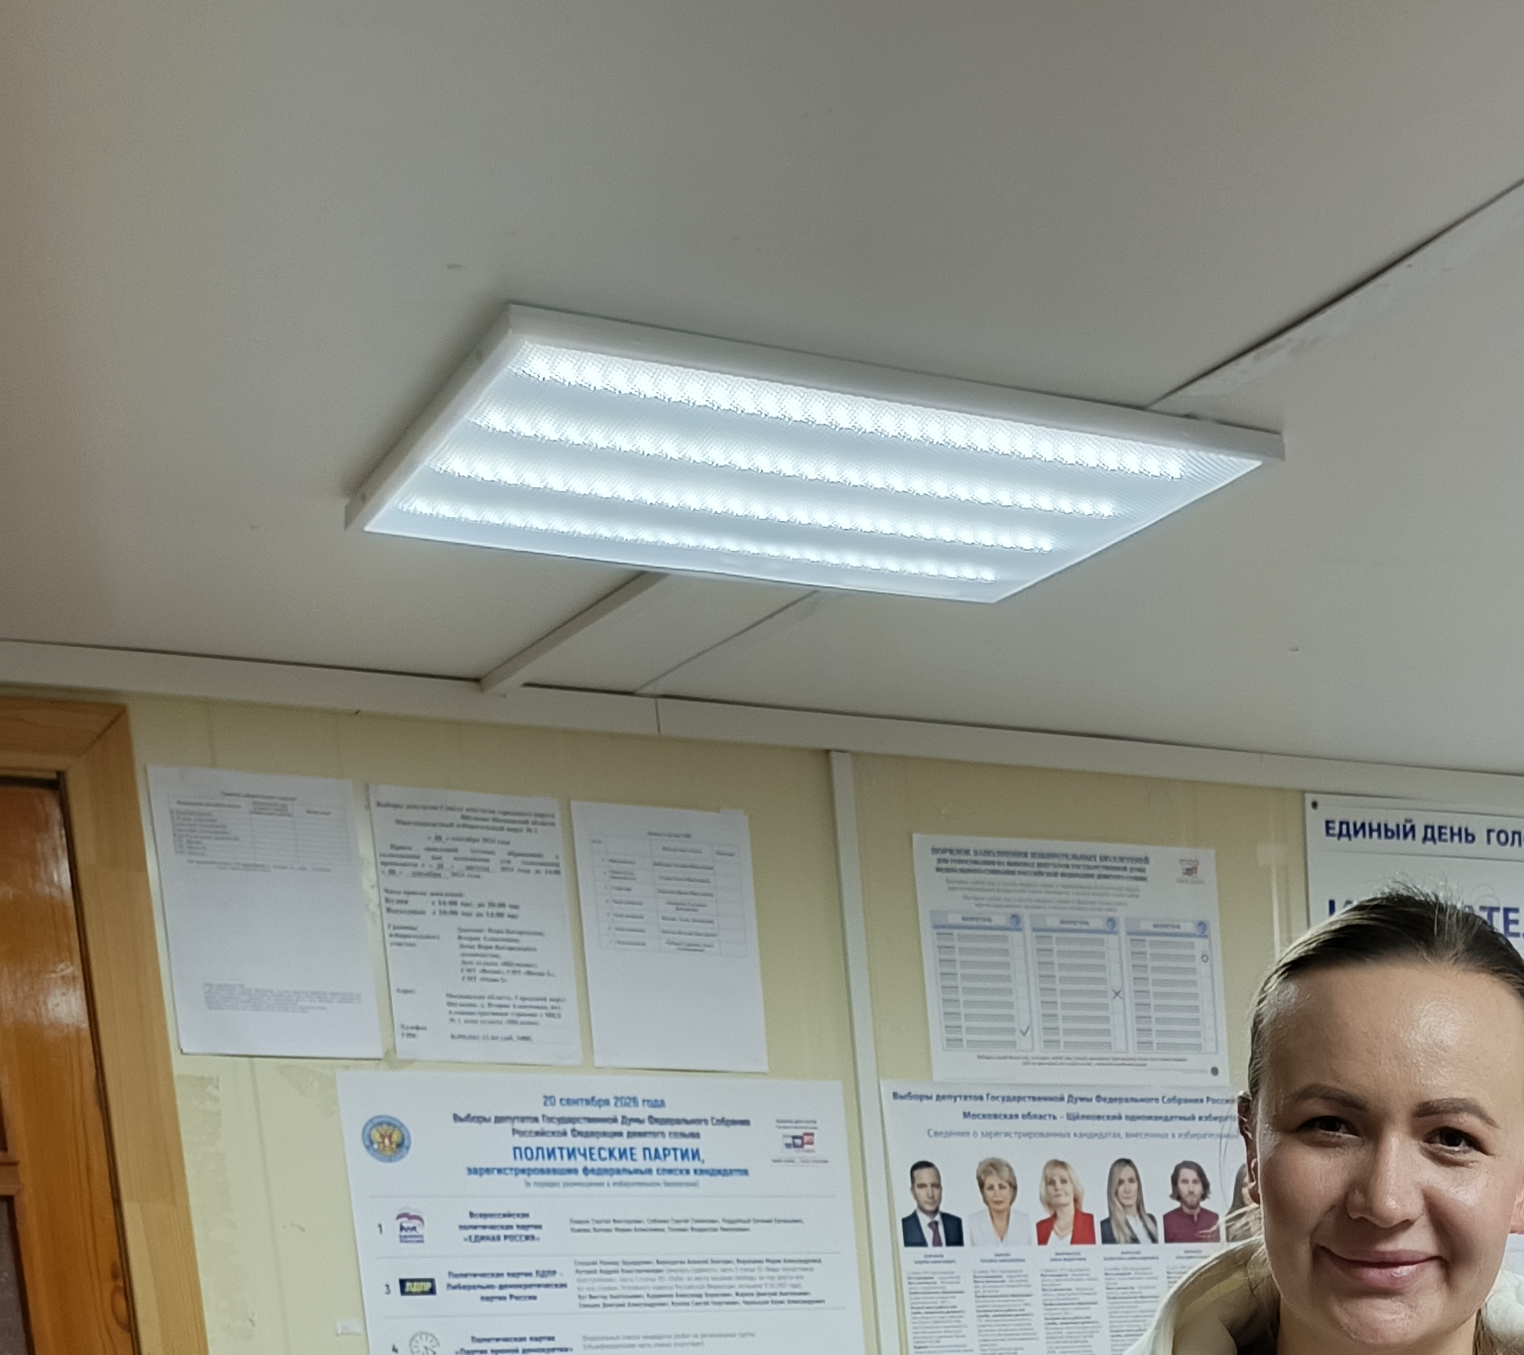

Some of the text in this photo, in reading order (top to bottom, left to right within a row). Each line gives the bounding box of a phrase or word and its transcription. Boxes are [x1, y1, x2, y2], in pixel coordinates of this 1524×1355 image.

[1325, 819, 1416, 841] ЕДИНЫЙ
[1422, 824, 1475, 845] ДЕНЬ
[512, 1146, 705, 1165] ПОЛИТИЧЕСКИЕ ПАРТИИ,
